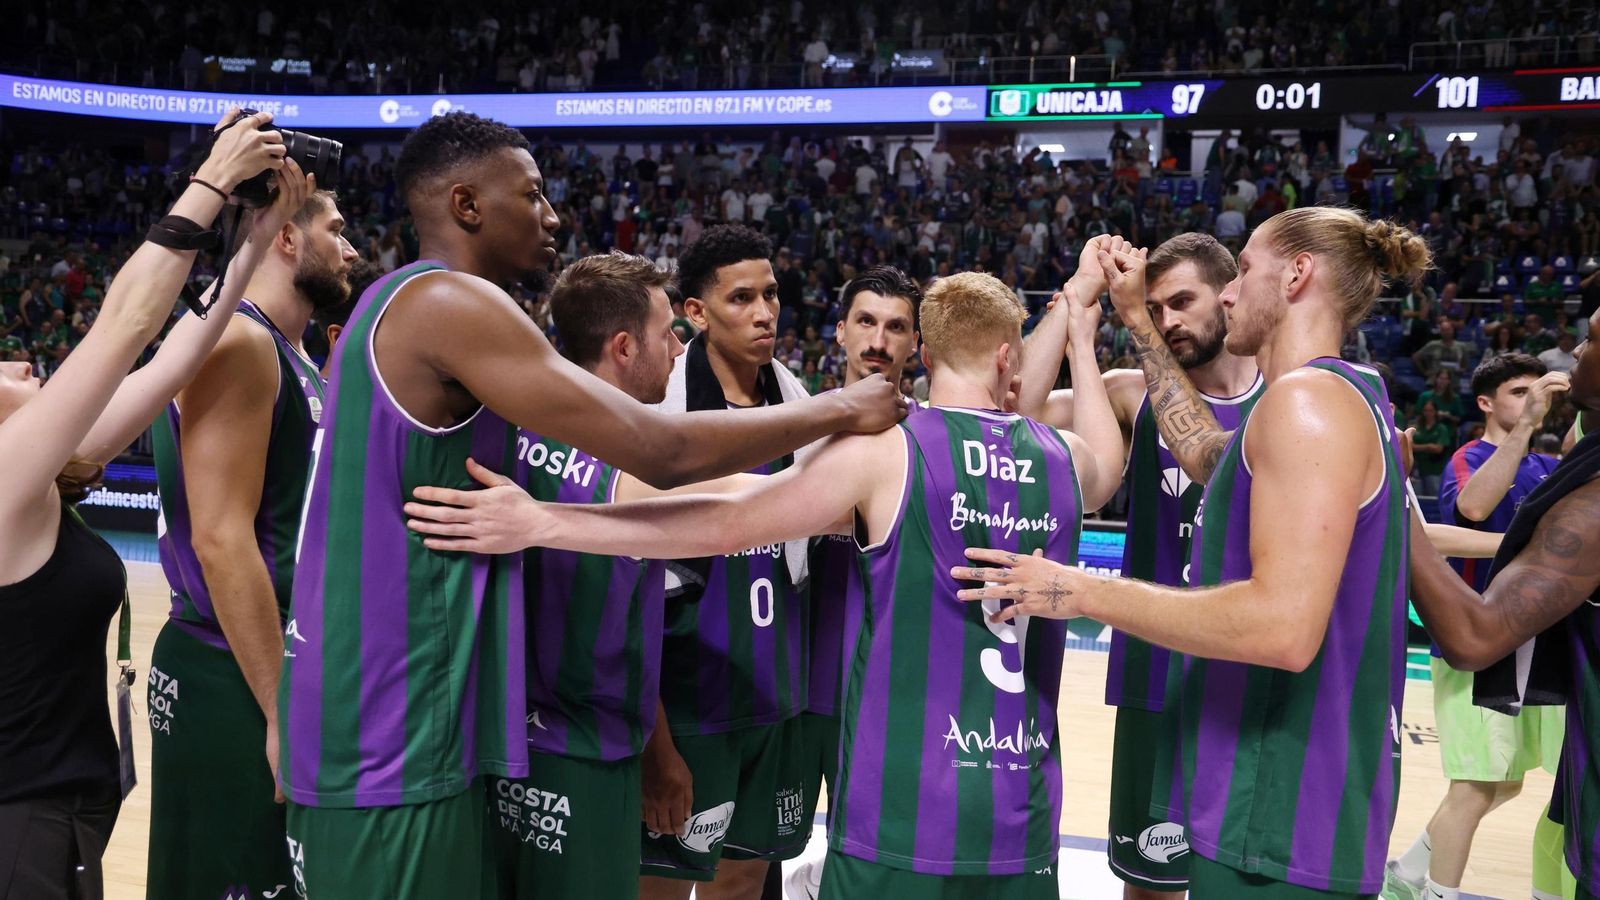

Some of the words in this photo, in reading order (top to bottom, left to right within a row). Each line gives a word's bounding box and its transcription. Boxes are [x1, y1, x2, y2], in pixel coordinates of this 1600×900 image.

[13, 82, 81, 104] ESTAMOS
[84, 89, 103, 106] EN
[107, 91, 165, 111] DIRECTO
[168, 96, 185, 112] EN
[556, 99, 614, 115] ESTAMOS
[616, 98, 634, 114] EN
[636, 97, 691, 115] DIRECTO
[694, 97, 712, 114] EN
[743, 97, 763, 113] FM
[765, 97, 775, 113] Y
[777, 96, 832, 113] COPE.es
[1036, 91, 1123, 114] UNICAJA
[1172, 84, 1205, 114] 97
[1255, 83, 1321, 110] 0:01
[1435, 76, 1479, 108] 101
[517, 426, 597, 487] noski
[963, 439, 1036, 484] Díaz
[81, 486, 159, 510] baloncesto
[750, 577, 774, 627] 0
[497, 779, 571, 817] COSTA
[529, 811, 567, 837] SOL
